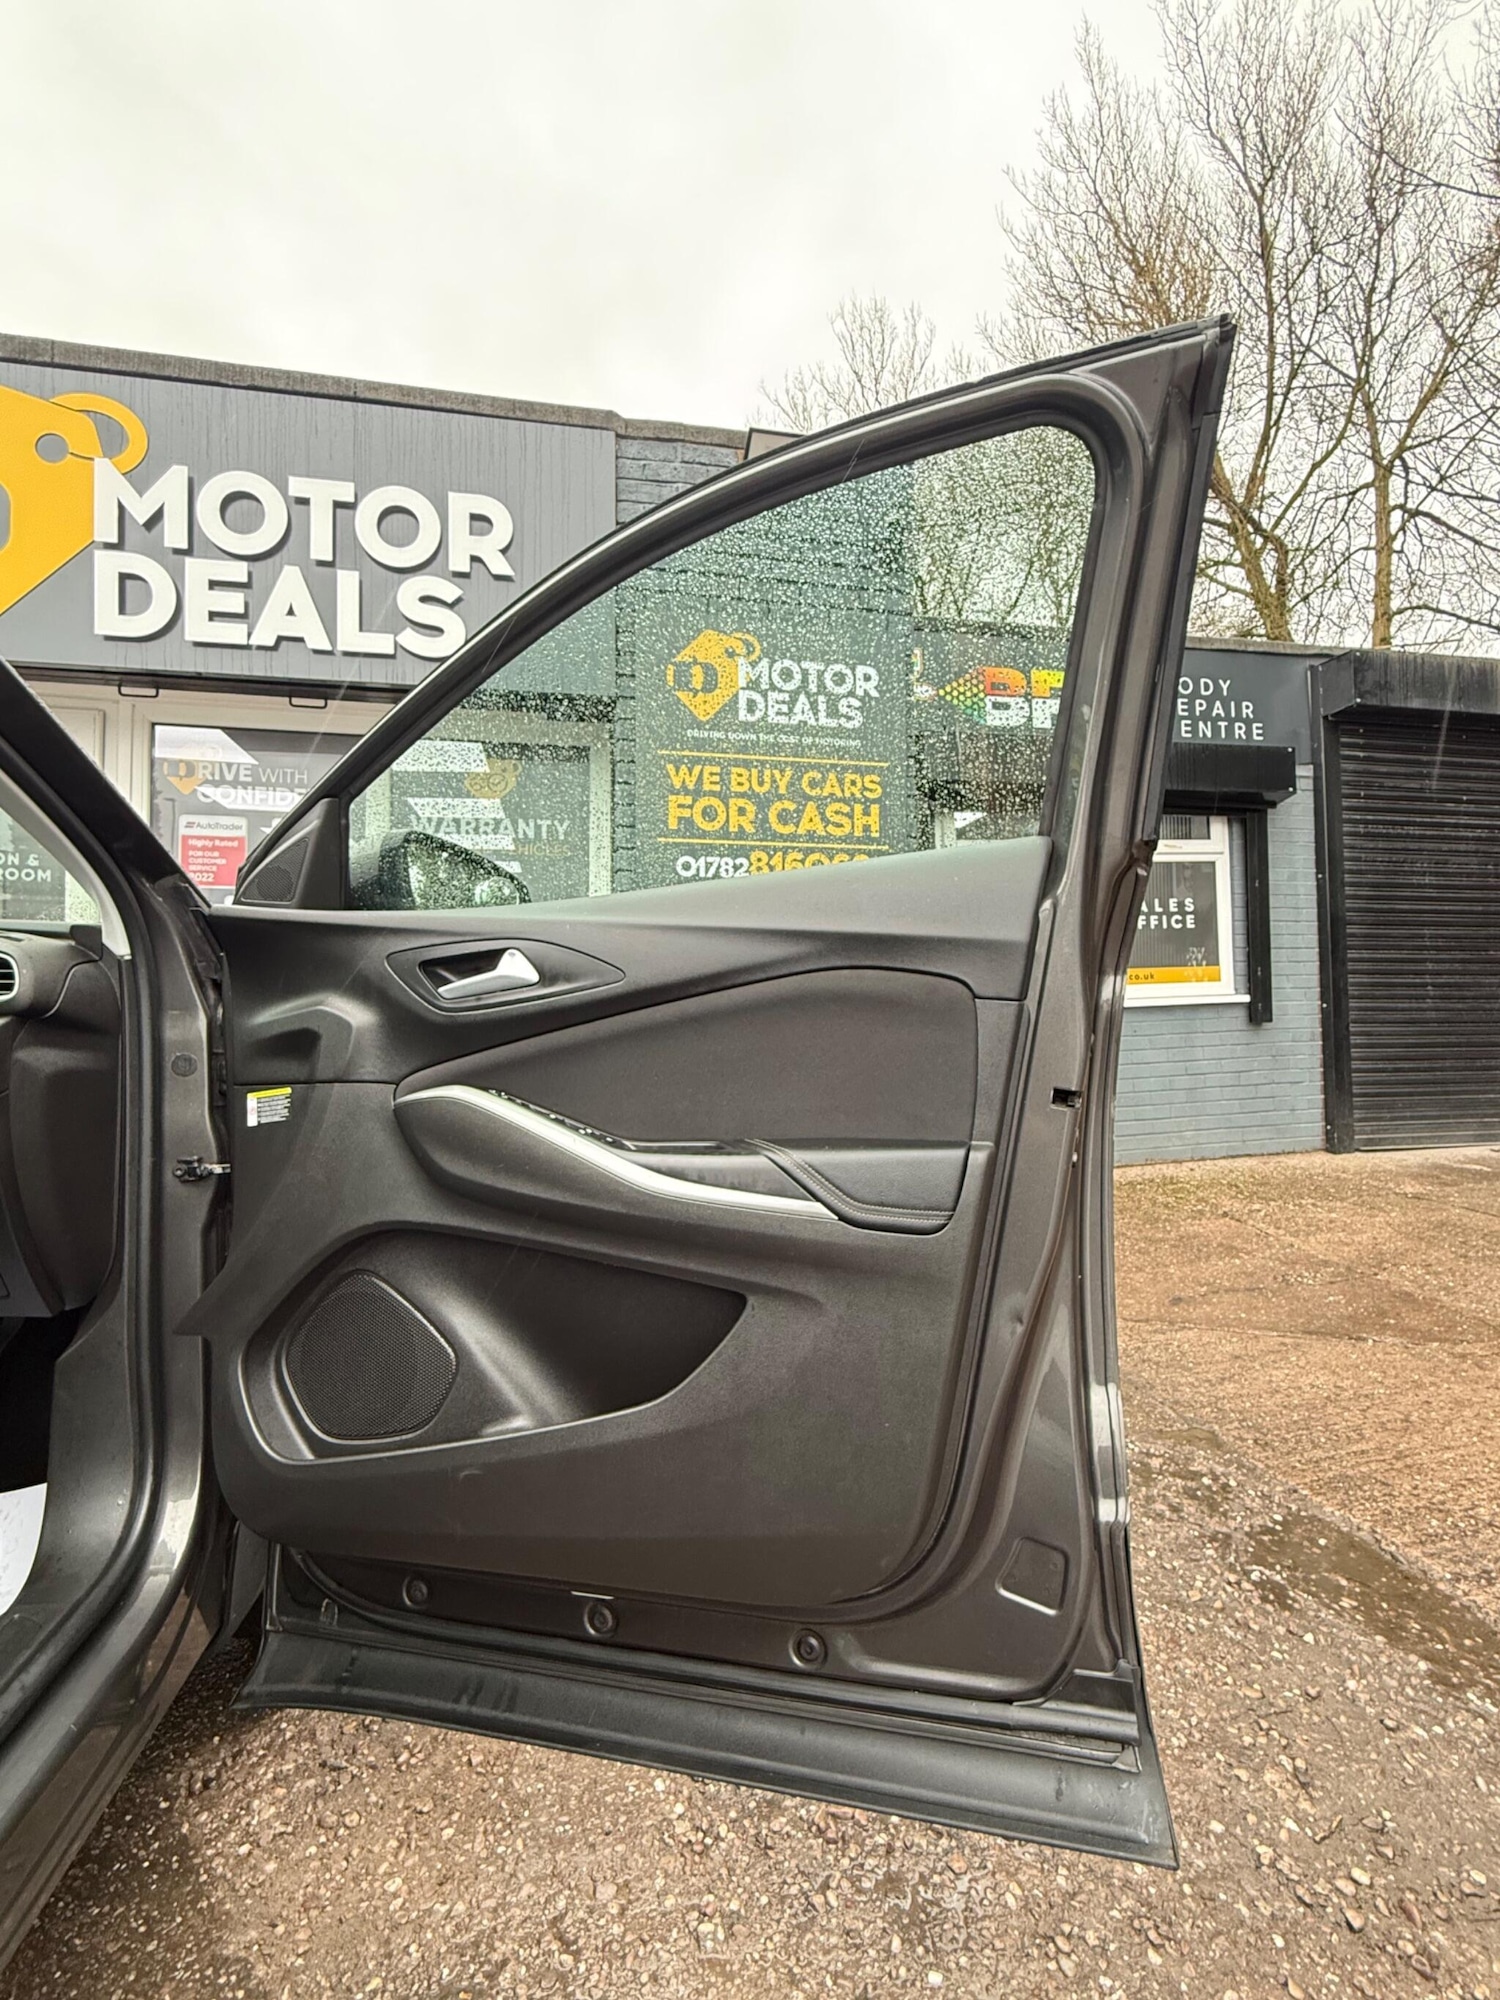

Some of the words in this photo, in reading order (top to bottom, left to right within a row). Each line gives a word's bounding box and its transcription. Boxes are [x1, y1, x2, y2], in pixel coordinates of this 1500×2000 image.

[94, 457, 515, 578] MOTOR
[94, 549, 467, 660] DEALS
[737, 656, 880, 698] MOTOR
[1178, 676, 1231, 697] ODY
[737, 689, 864, 729] DEALS
[1177, 698, 1254, 719] EPAIR
[1180, 719, 1264, 740] ENTRE
[259, 767, 308, 785] WITH
[666, 763, 721, 792] WE
[730, 766, 793, 794] BUY
[801, 770, 883, 799] CARS
[196, 821, 244, 831] AutoTrader
[667, 795, 756, 833] FOR
[768, 800, 880, 838] CASH
[410, 815, 572, 841] WARRANTY
[188, 839, 214, 848] Highly
[214, 839, 239, 848] Rated
[188, 850, 203, 858] FOR
[28, 853, 40, 867] &
[0, 867, 52, 882] OOM
[1140, 897, 1195, 913] ALES
[1137, 914, 1196, 930] FFICE
[1128, 972, 1155, 981] co.uk
